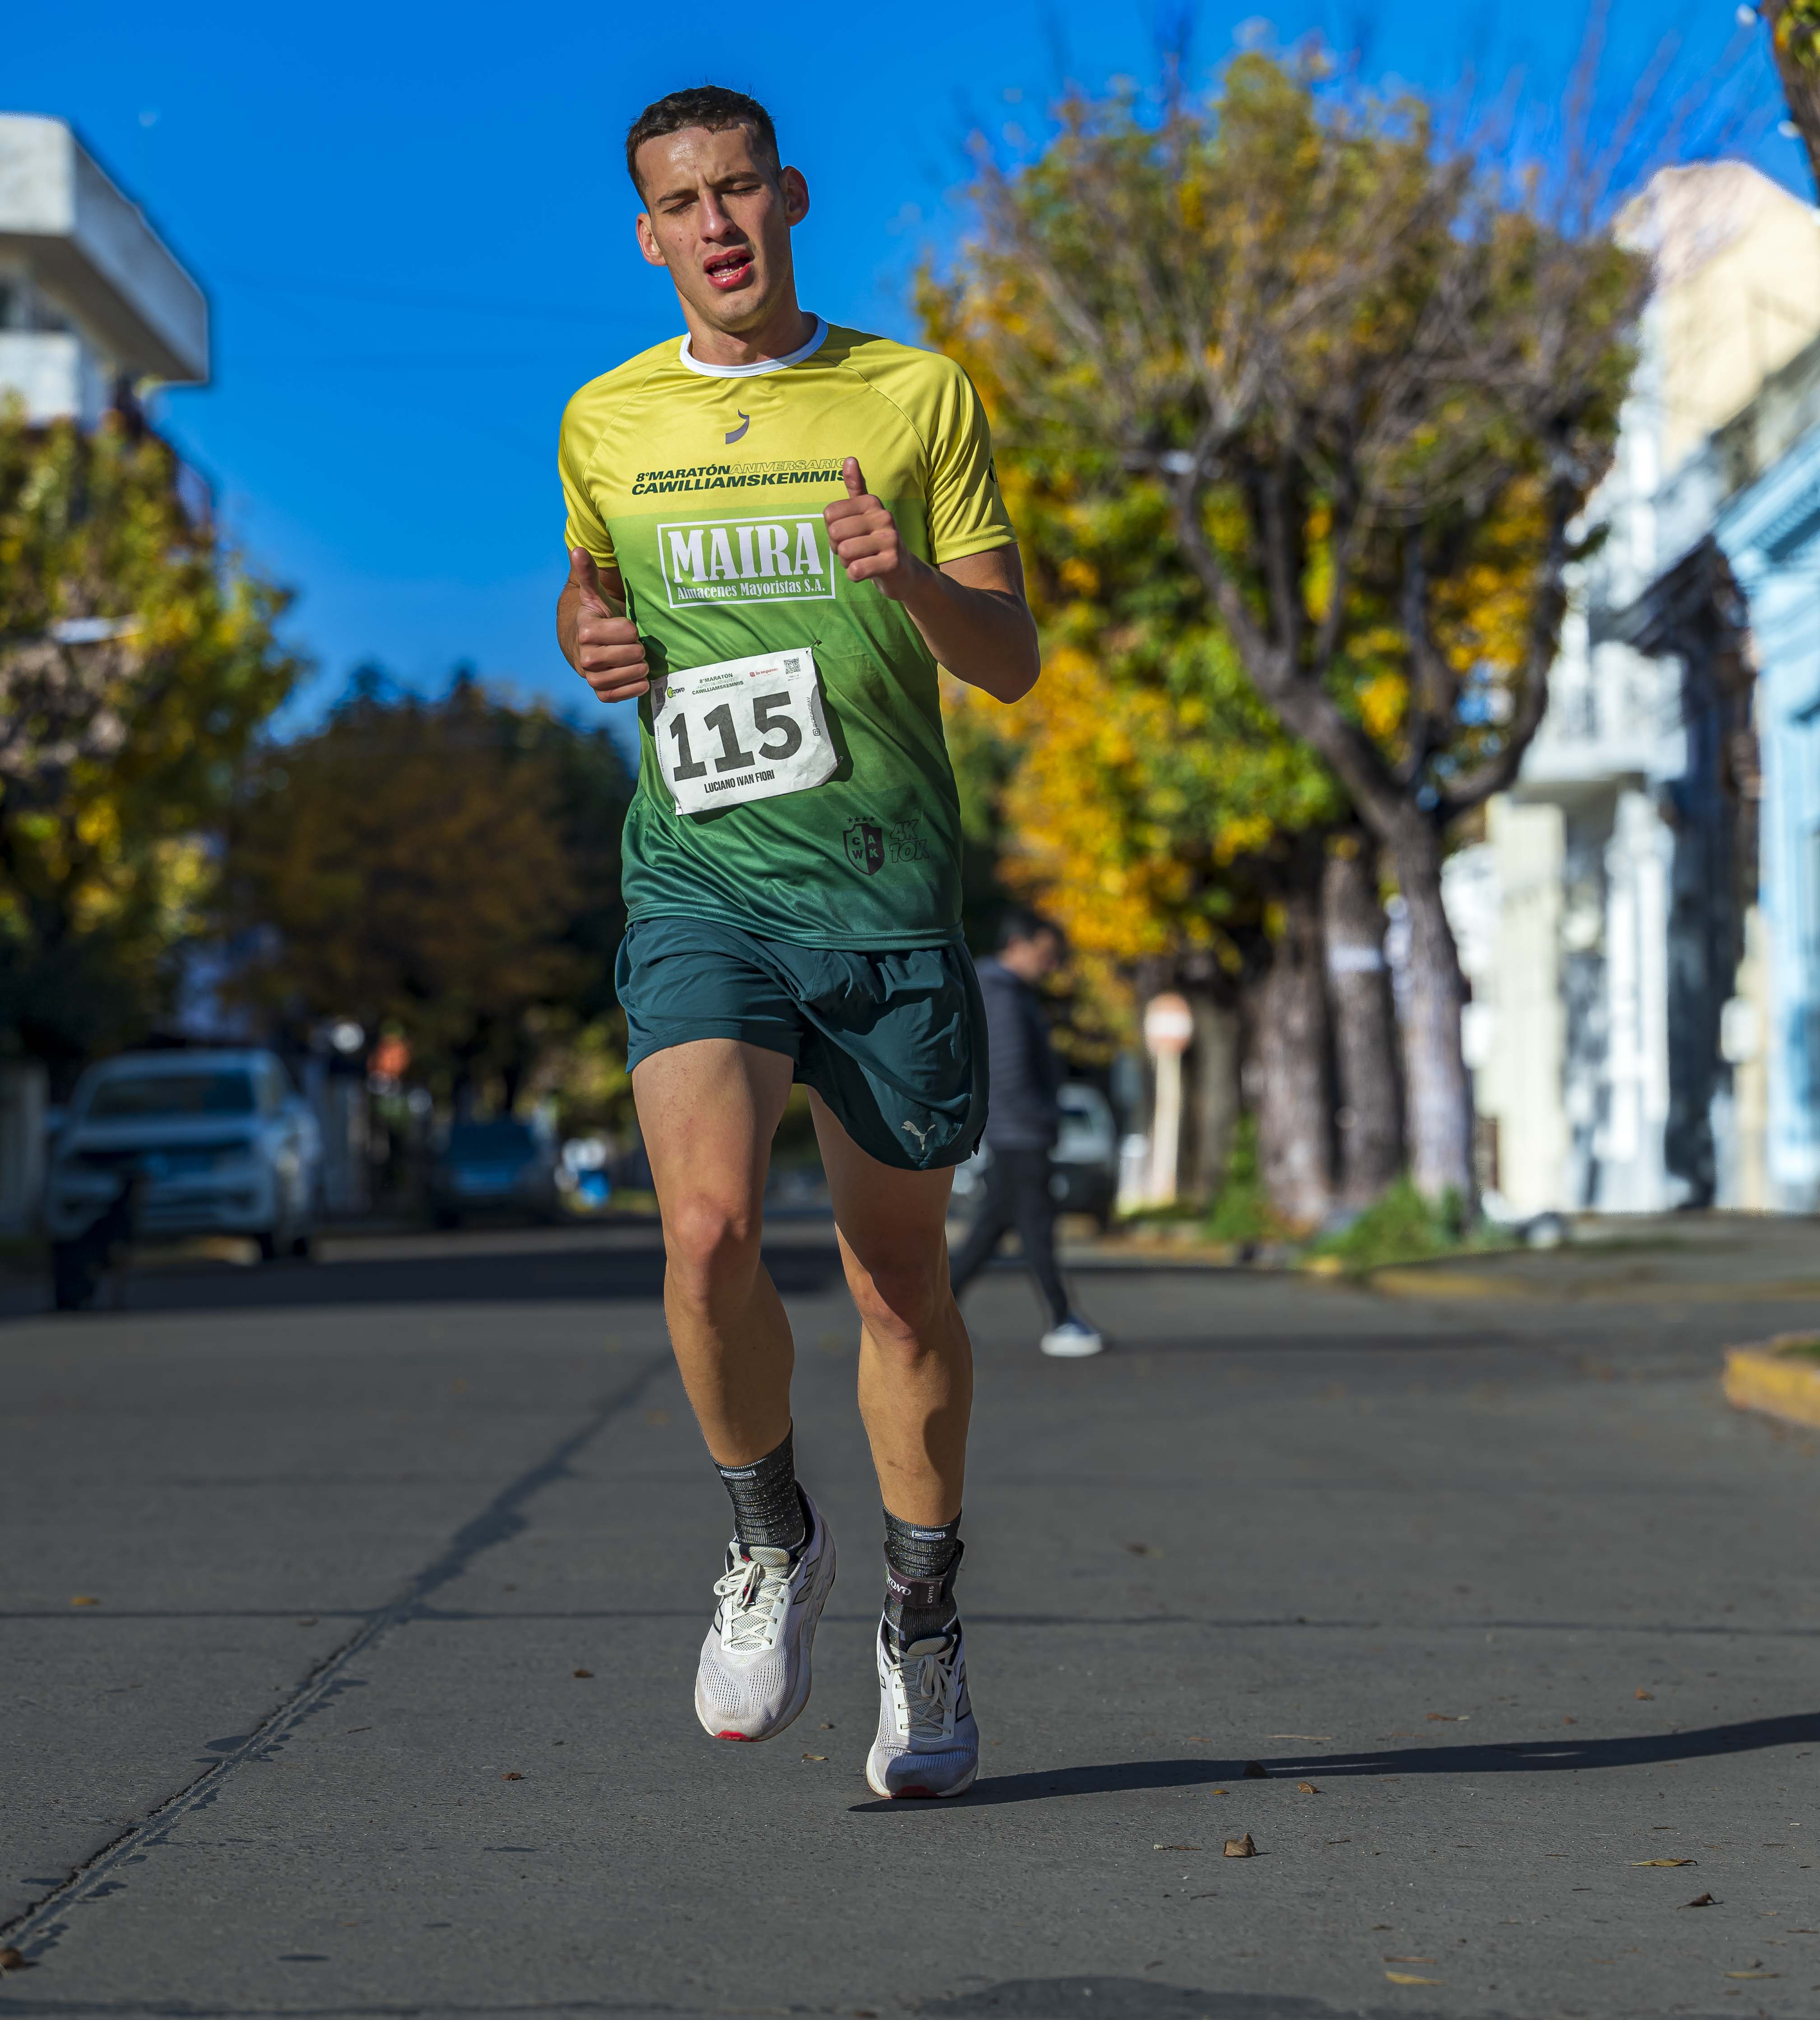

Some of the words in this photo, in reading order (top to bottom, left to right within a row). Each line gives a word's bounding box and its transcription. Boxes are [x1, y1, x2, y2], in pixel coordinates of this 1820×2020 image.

[668, 523, 824, 583] MAIRA
[678, 586, 738, 600] Almacenes
[739, 580, 802, 598] Mayoristas
[803, 579, 826, 593] S.A.
[692, 680, 744, 695] CAWILLIAMSKEMMIS
[669, 691, 802, 782] 115
[704, 778, 736, 793] LUCIANO
[736, 774, 755, 786] IVAN
[755, 769, 775, 782] FIORI
[890, 819, 919, 841] 4K
[889, 839, 930, 863] 10K
